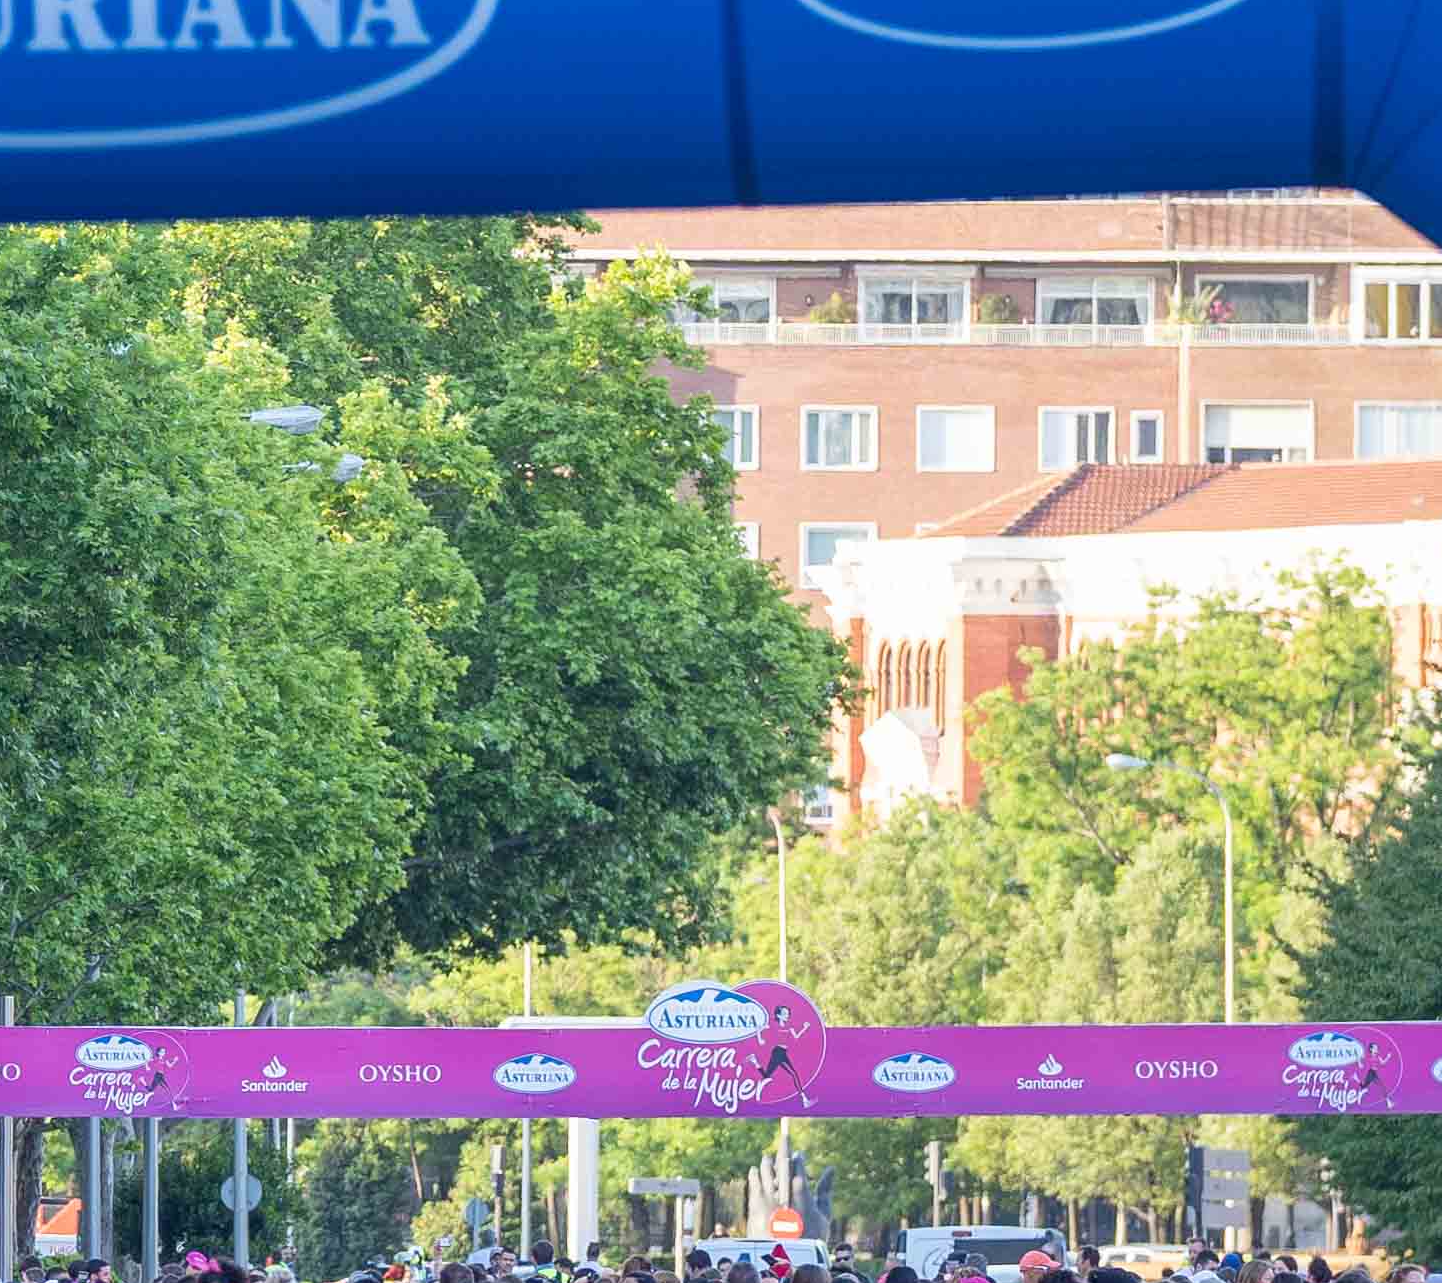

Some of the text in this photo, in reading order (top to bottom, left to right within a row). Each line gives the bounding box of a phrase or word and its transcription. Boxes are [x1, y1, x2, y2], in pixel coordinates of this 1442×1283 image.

[657, 1007, 758, 1029] ASTURIANA
[82, 1047, 146, 1062] ASTURIANA
[637, 1037, 737, 1068] Carrera
[1295, 1045, 1360, 1059] ASTURIANA
[69, 1066, 132, 1087] Carrera
[358, 1063, 443, 1083] OYSHO
[499, 1067, 571, 1084] ASTURIANA
[878, 1066, 951, 1083] ASTURIANA
[1134, 1059, 1220, 1079] OYSHO
[1282, 1065, 1346, 1084] Carrera
[241, 1079, 309, 1093] Santander
[662, 1065, 773, 1114] de la Mujer
[1016, 1077, 1085, 1091] Santander
[84, 1086, 96, 1100] de
[105, 1084, 155, 1114] Mujer
[1318, 1082, 1368, 1112] Mujer
